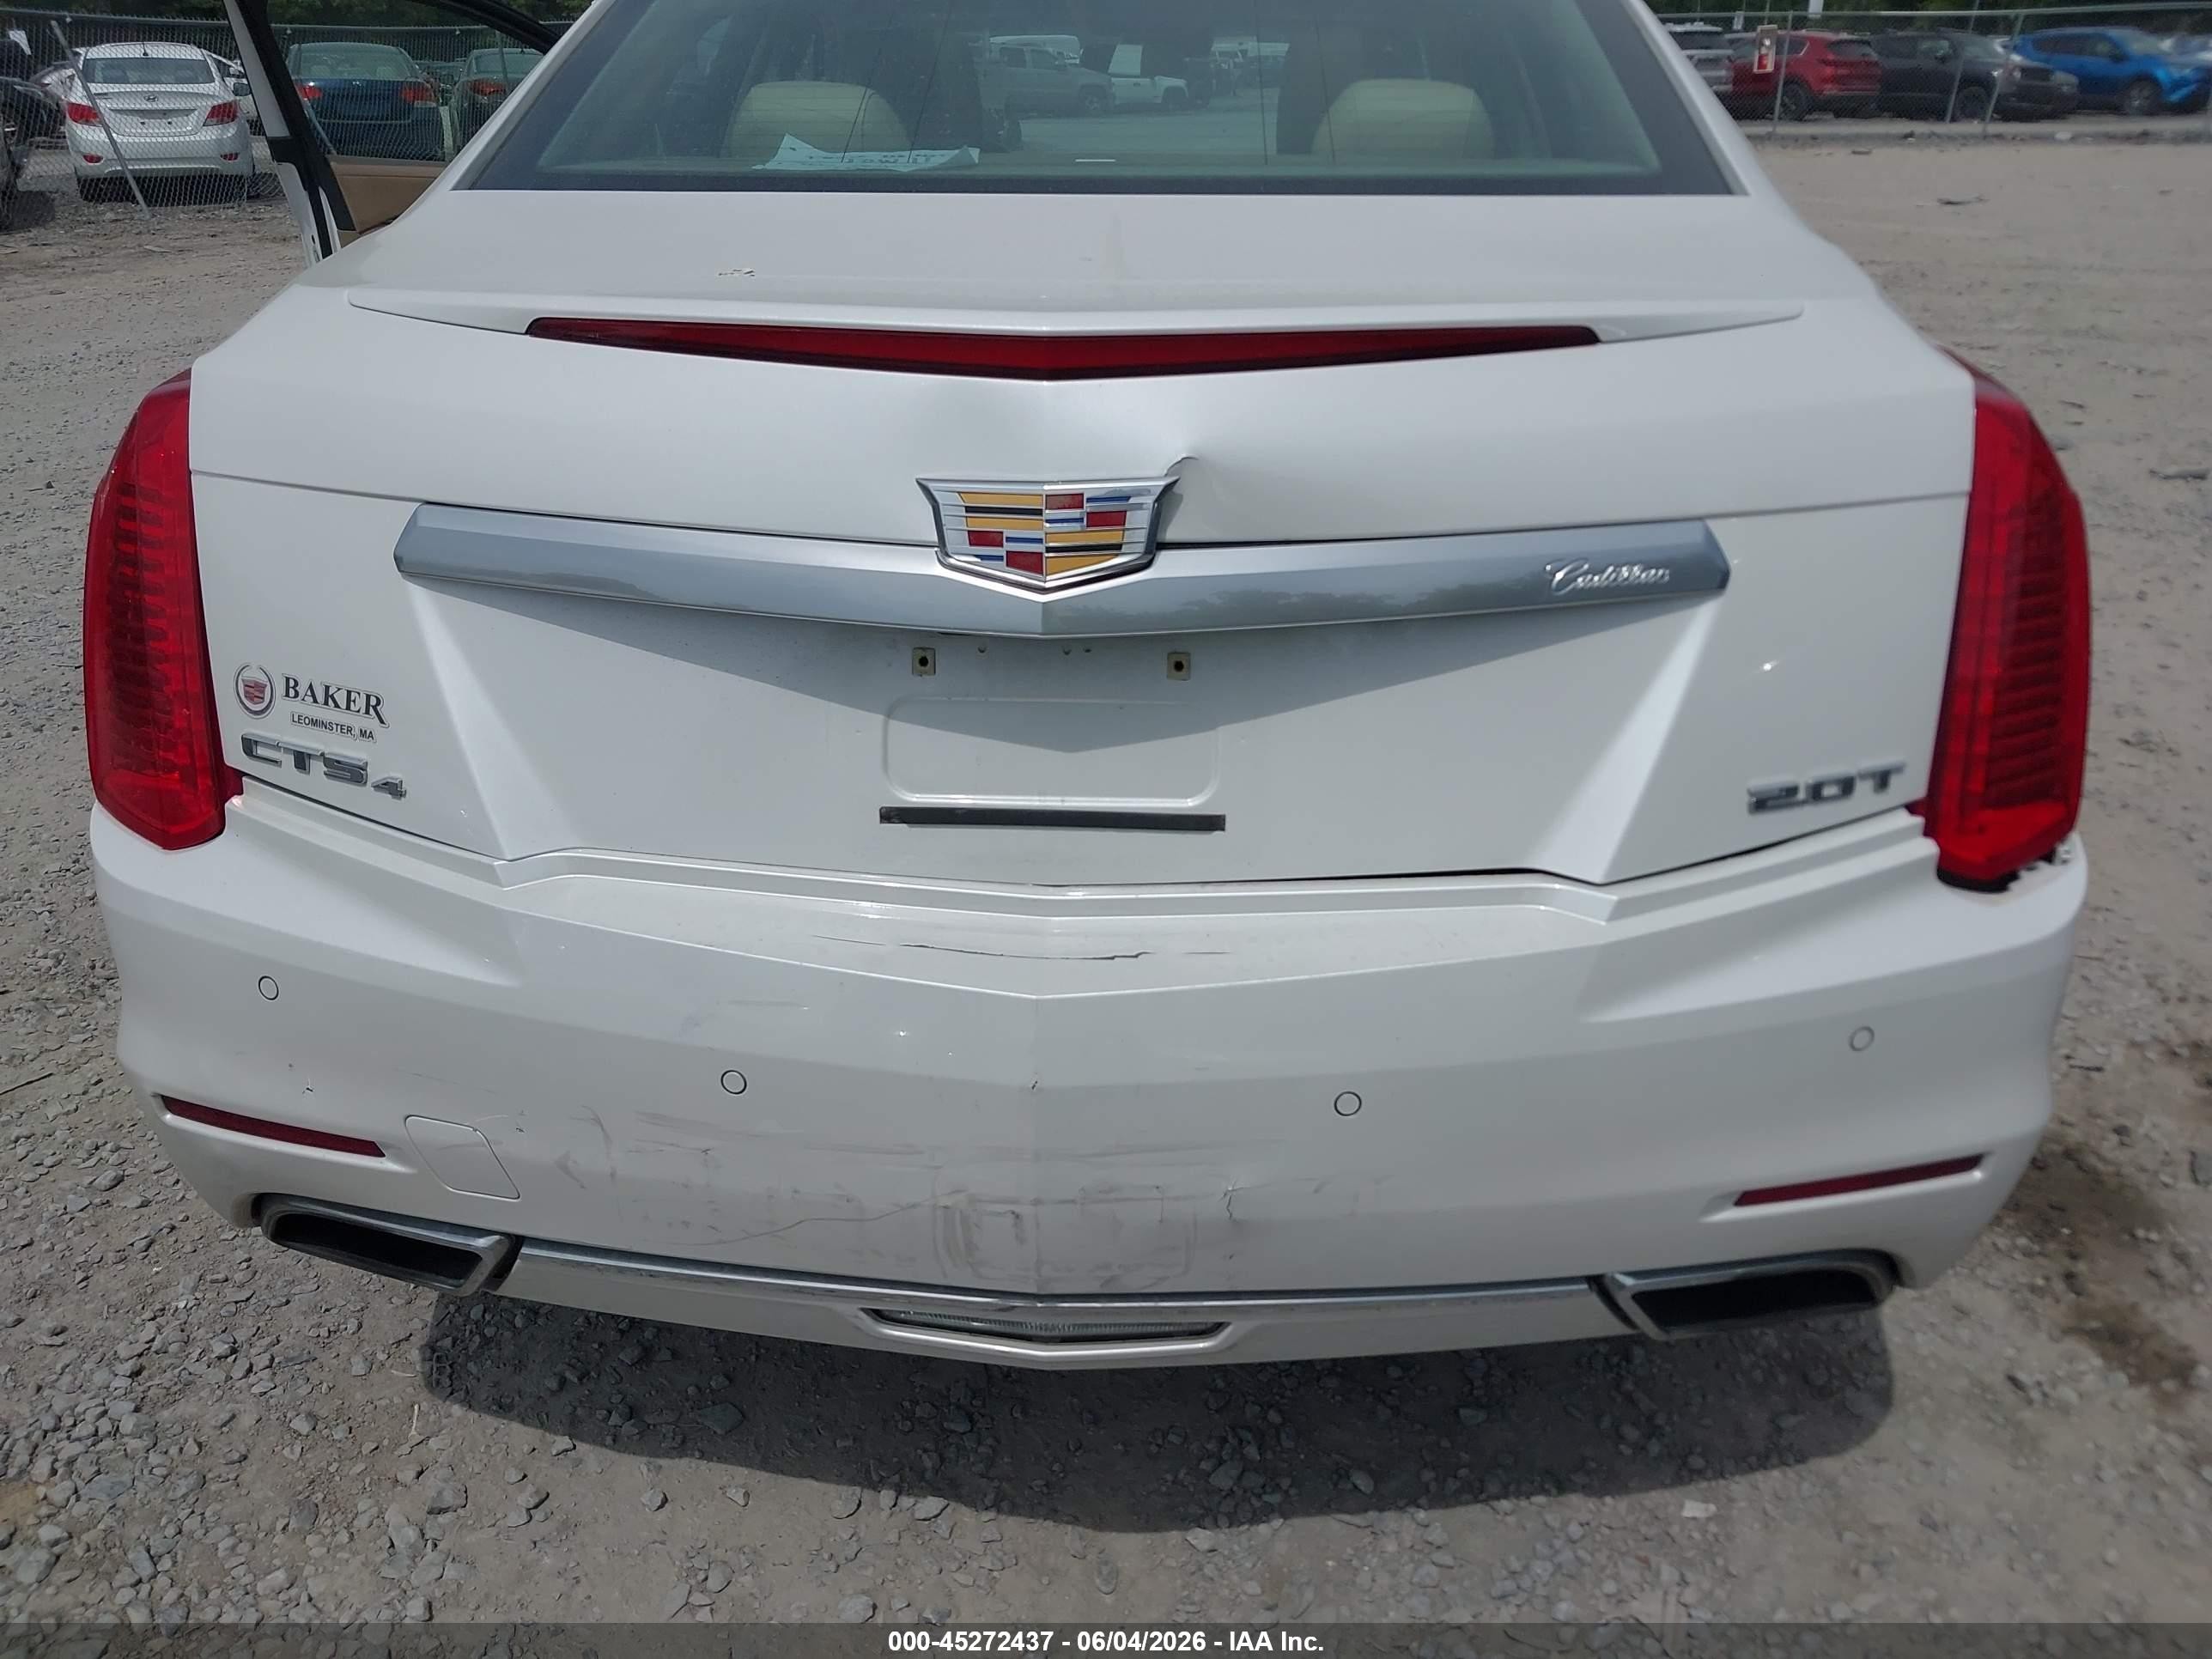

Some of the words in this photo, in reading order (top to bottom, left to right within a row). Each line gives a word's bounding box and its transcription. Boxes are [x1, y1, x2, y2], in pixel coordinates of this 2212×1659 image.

[283, 675, 387, 726] BAKER
[292, 714, 357, 738] LEOMINSTER,
[359, 728, 374, 741] MA
